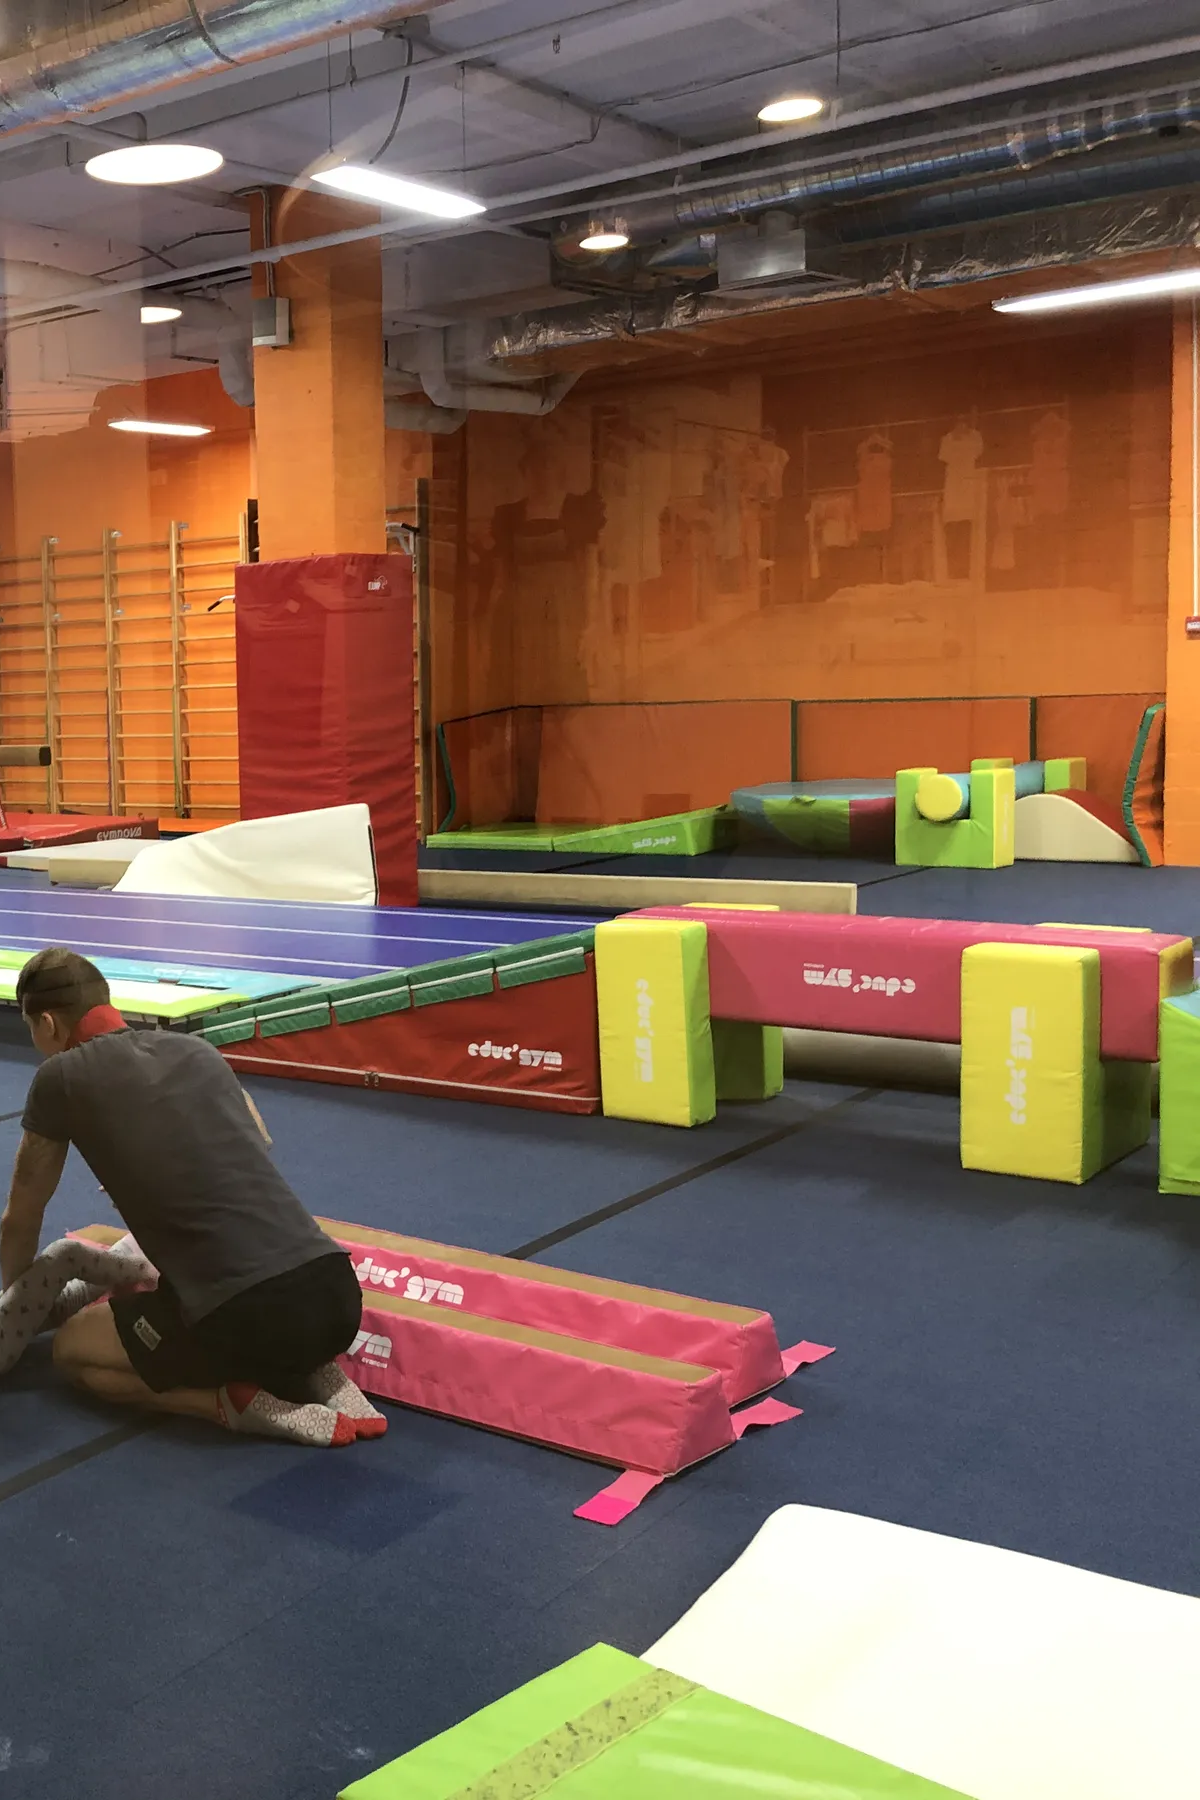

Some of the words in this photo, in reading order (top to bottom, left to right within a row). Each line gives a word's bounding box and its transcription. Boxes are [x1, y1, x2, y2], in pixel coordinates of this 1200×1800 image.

[96, 826, 142, 841] GYMNOVA
[467, 1040, 563, 1067] educ'gym
[350, 1257, 465, 1306] duc'gym
